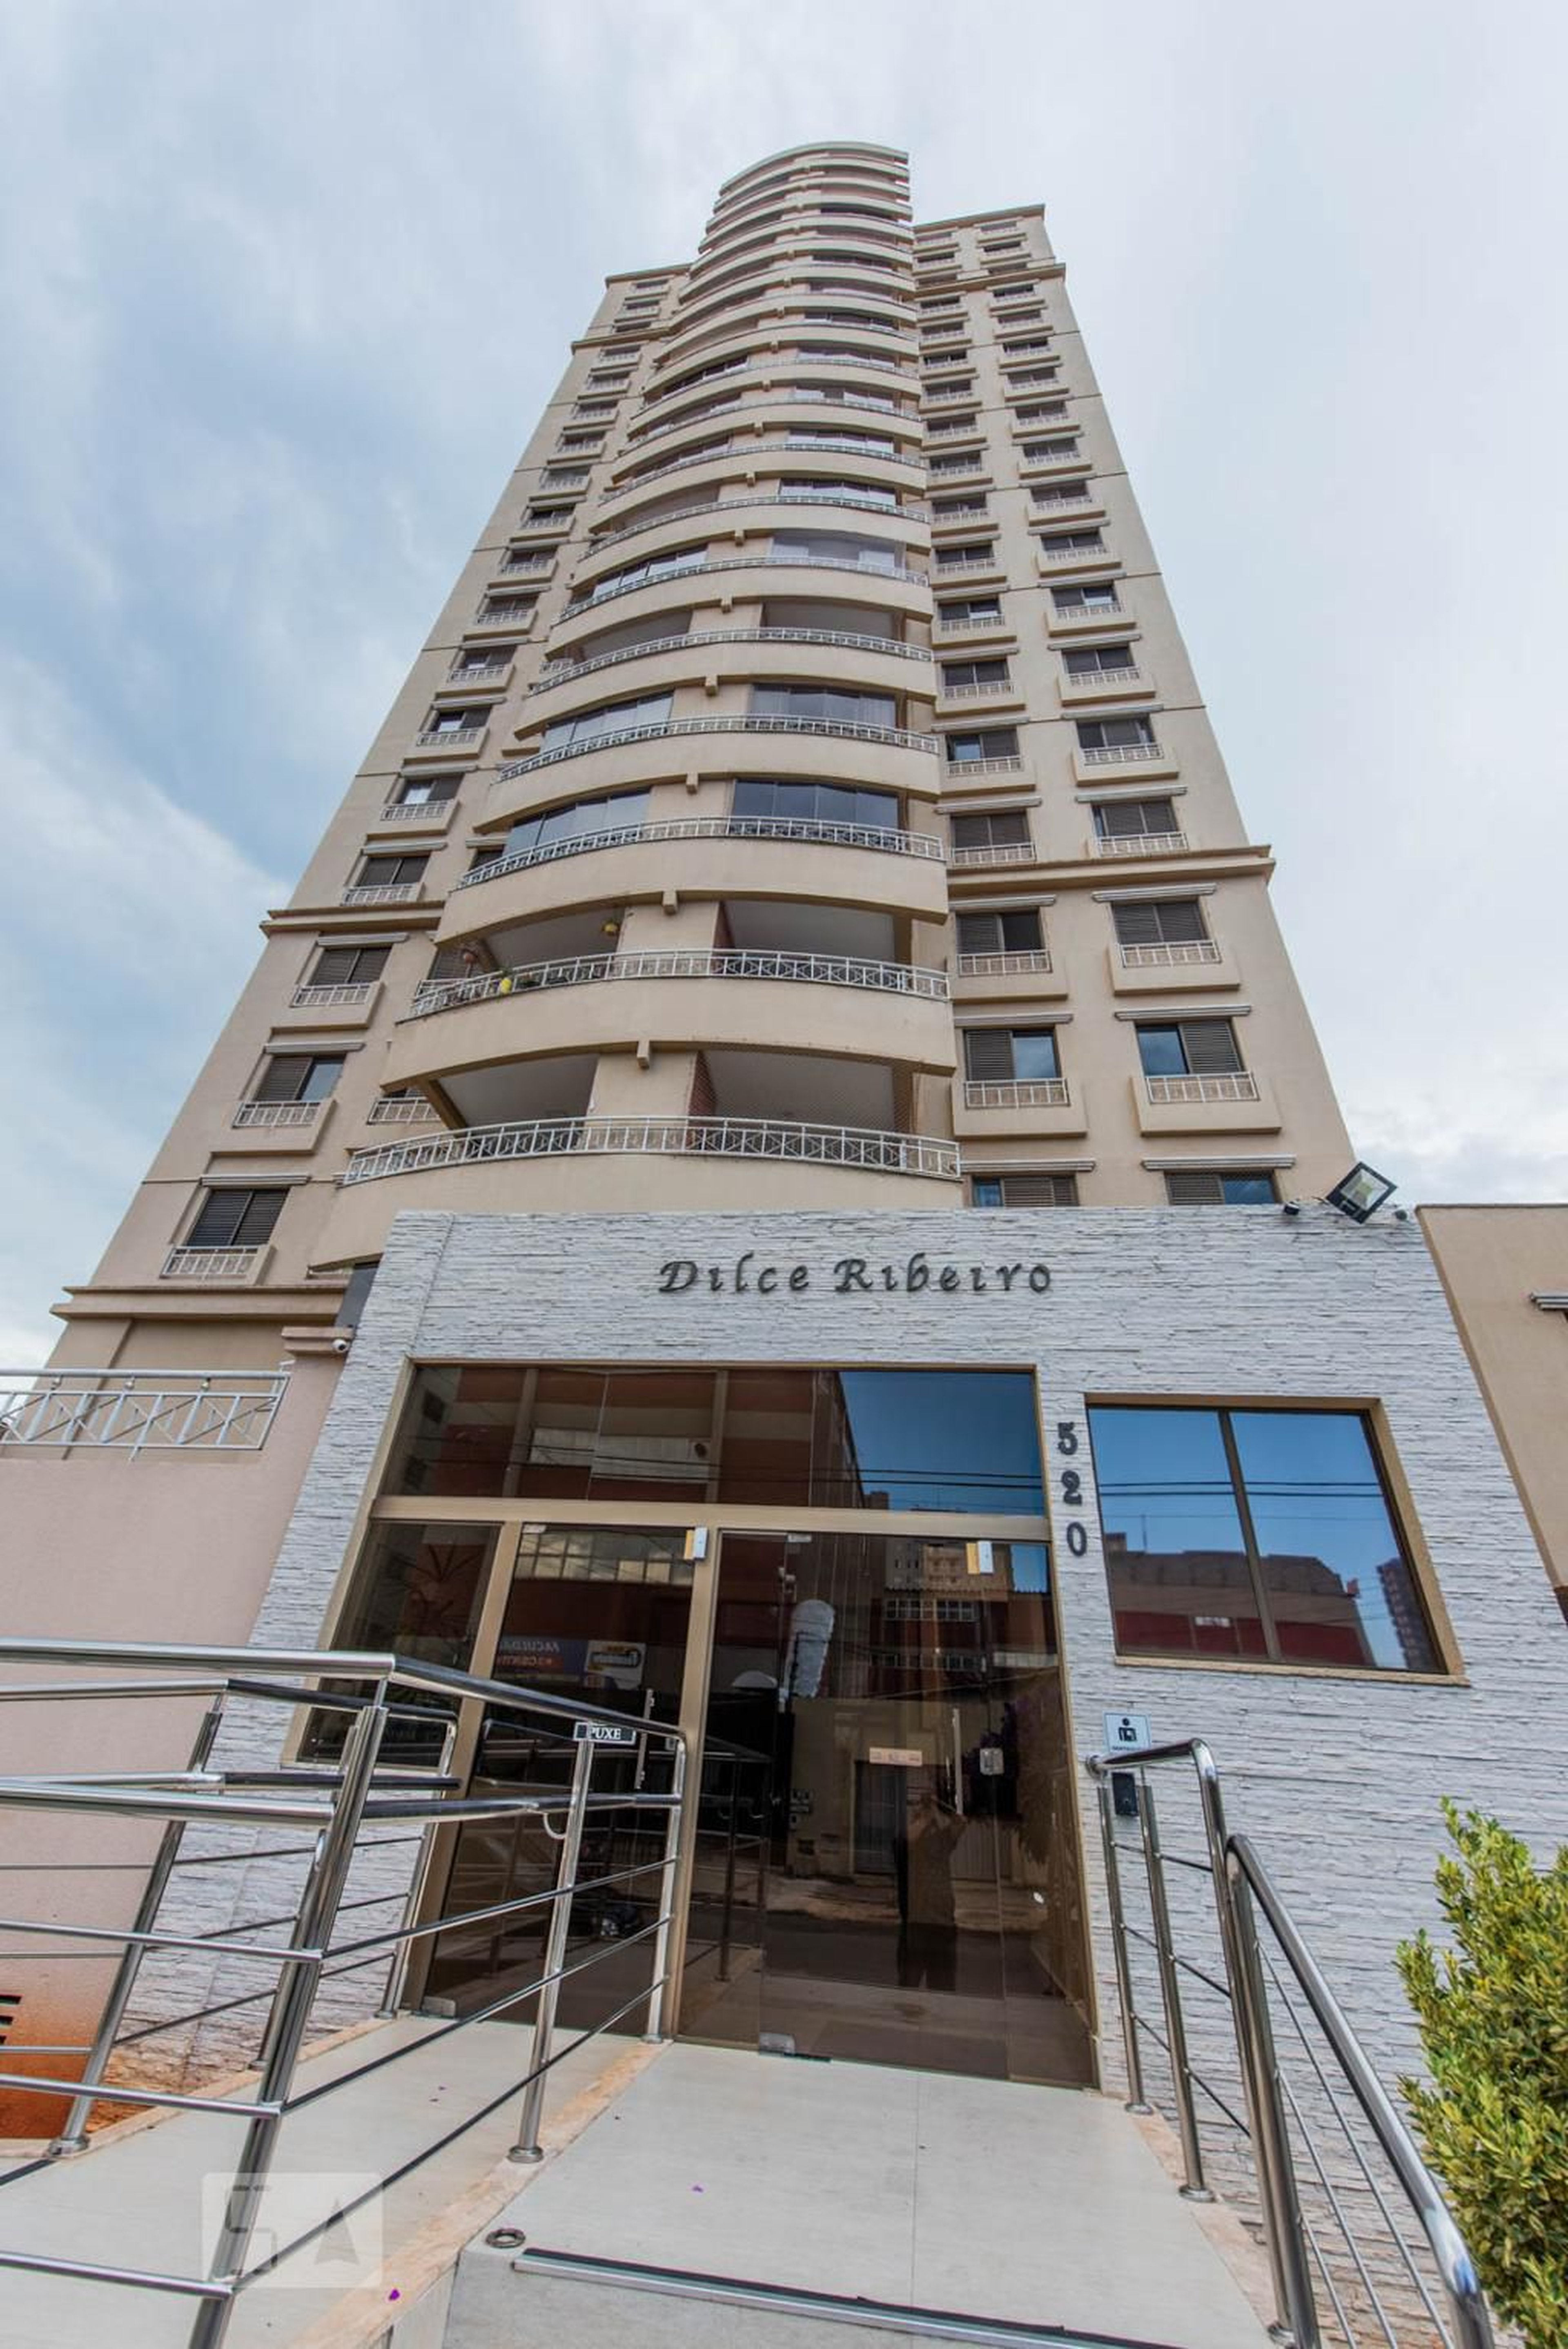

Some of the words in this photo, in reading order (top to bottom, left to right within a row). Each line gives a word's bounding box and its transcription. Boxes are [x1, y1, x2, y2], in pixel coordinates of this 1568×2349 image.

[659, 1252, 809, 1293] Dilce
[834, 1252, 1051, 1293] Ribeiro
[1058, 1422, 1087, 1556] 520
